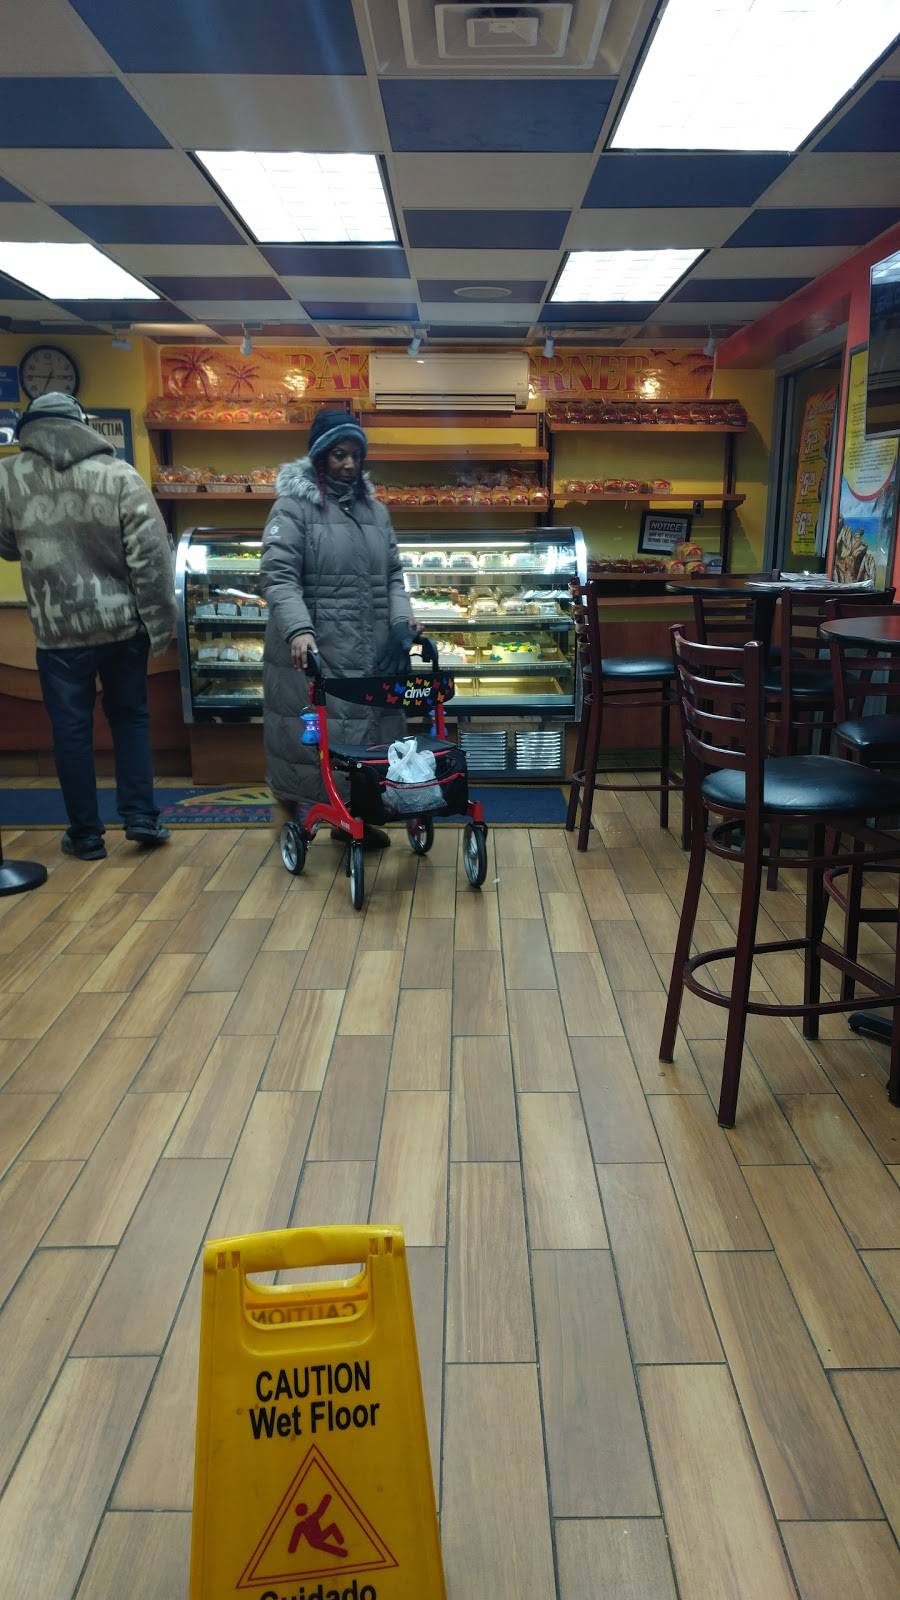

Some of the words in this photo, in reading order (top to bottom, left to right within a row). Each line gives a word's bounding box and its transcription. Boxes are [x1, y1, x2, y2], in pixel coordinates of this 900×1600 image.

[285, 353, 369, 390] BAK
[530, 355, 654, 391] RNER
[650, 521, 682, 532] NOTICE
[404, 687, 431, 699] drive
[256, 1360, 371, 1402] CAUTION
[249, 1405, 302, 1440] Wet
[310, 1401, 380, 1434] Floor
